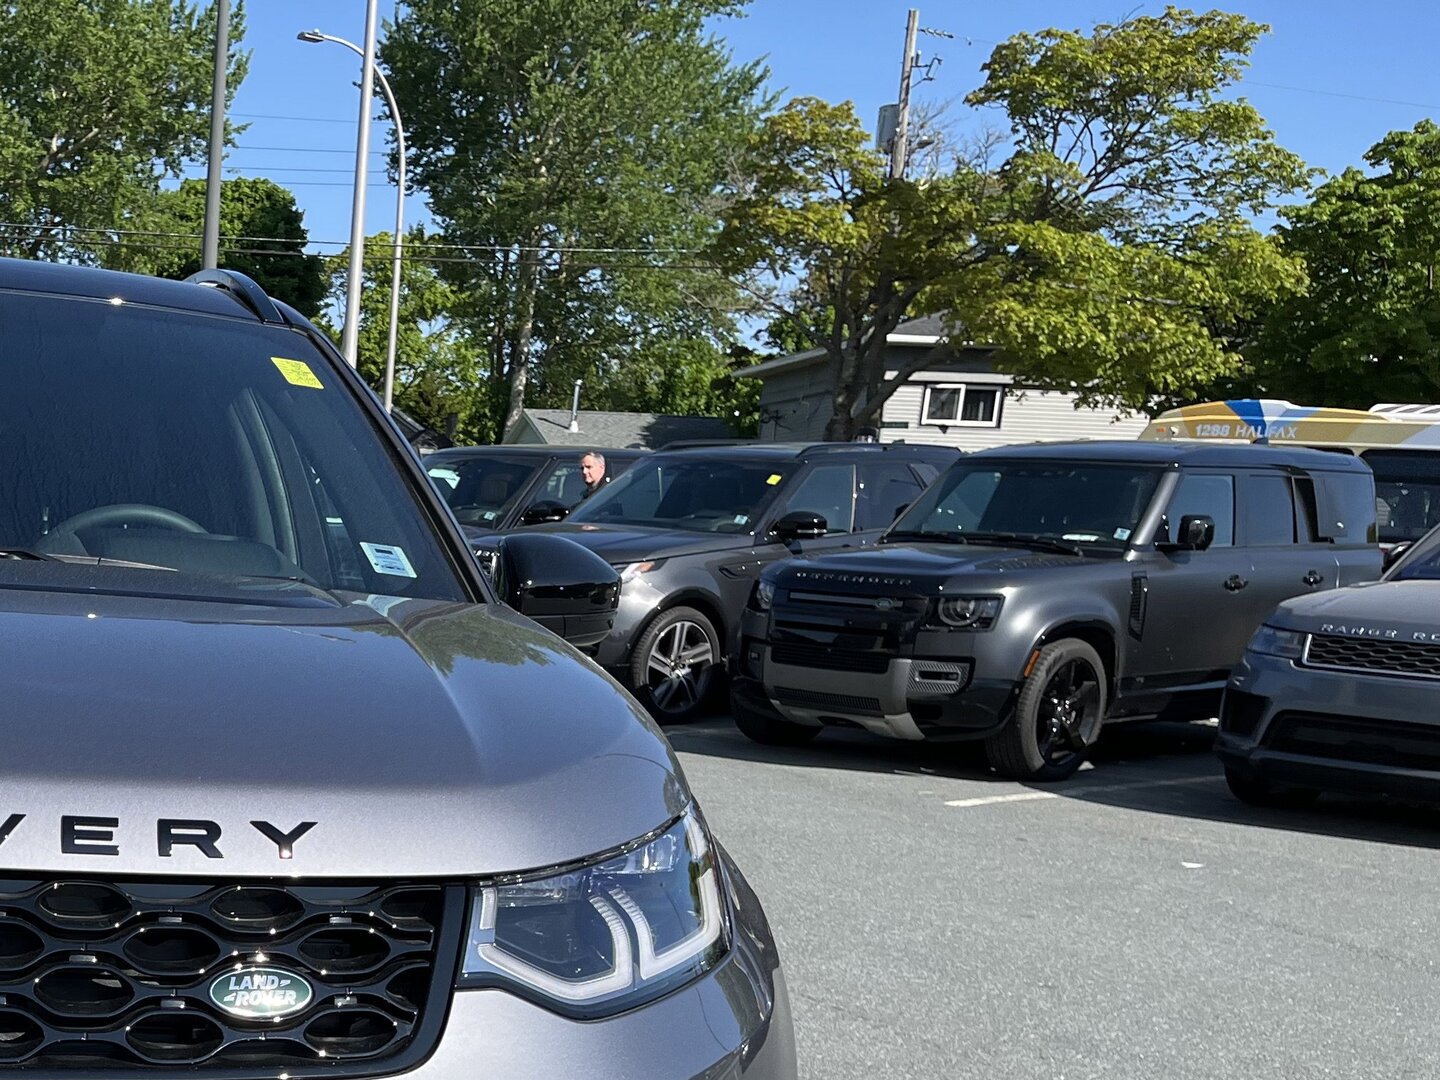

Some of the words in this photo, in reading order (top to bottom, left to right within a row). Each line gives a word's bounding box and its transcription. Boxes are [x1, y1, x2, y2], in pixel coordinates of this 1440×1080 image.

[1235, 424, 1298, 439] HALIFAX
[1321, 623, 1397, 639] RANGE
[228, 974, 279, 991] LAND
[234, 989, 297, 1007] ROVER
